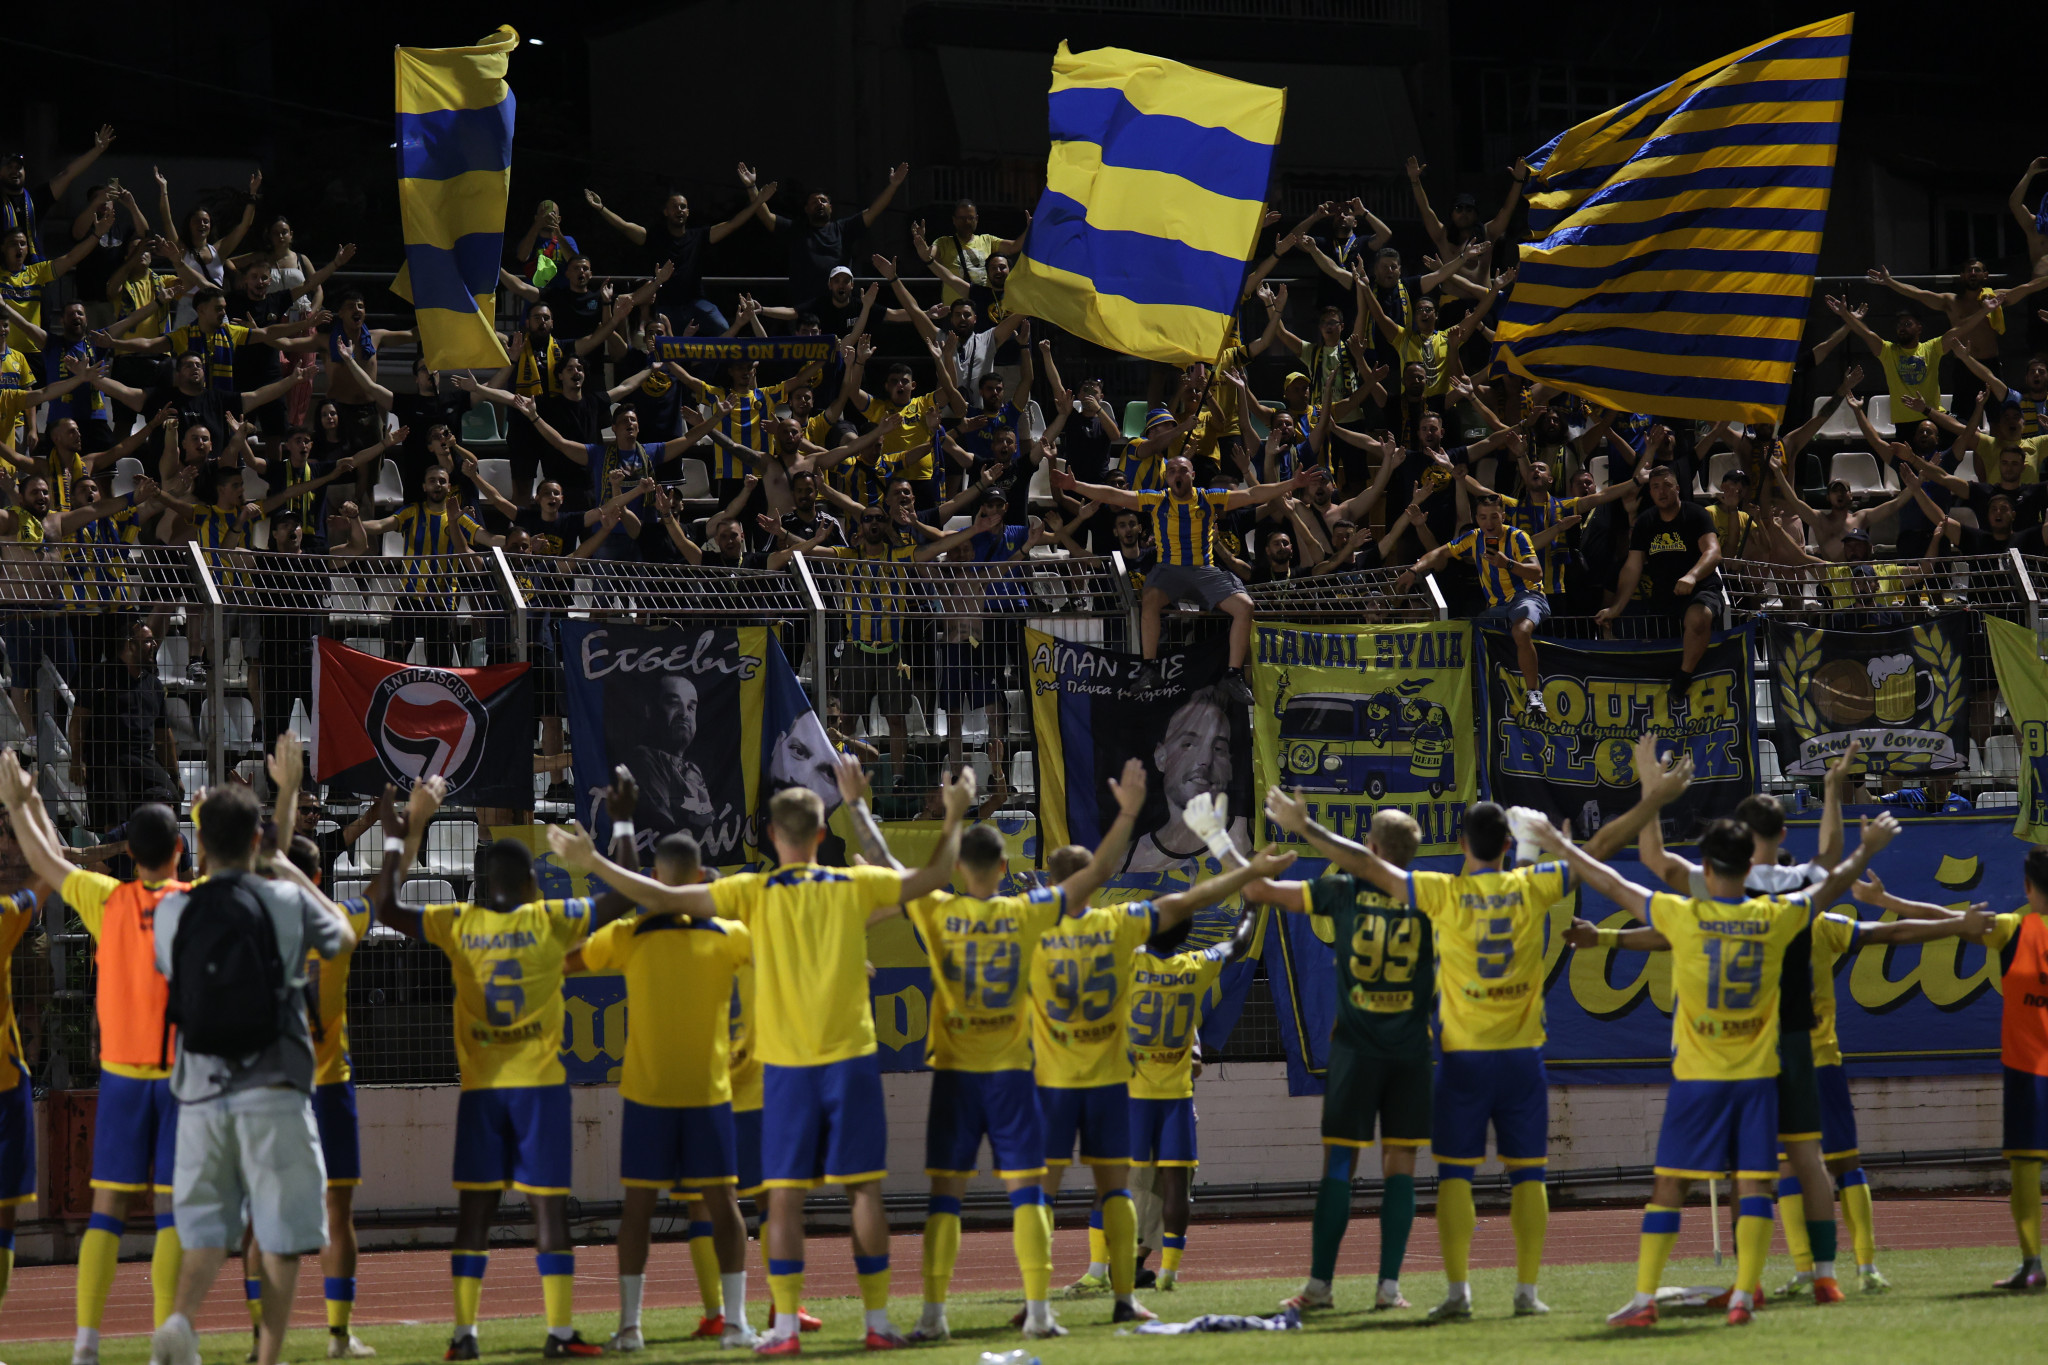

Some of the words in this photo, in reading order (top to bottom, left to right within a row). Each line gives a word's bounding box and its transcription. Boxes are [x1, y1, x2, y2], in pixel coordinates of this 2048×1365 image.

[662, 343, 742, 360] ALWAYS
[747, 344, 774, 359] ON
[778, 343, 830, 360] TOUR
[1257, 627, 1369, 674] ΠΑΝΑΙ,
[1375, 632, 1466, 669] ΞΥΔΙΑ
[383, 669, 475, 706] ANTIFASCIST
[1117, 681, 1186, 701] μχητής.
[1497, 663, 1738, 728] YOUTH
[1515, 712, 1556, 732] Made
[1559, 721, 1576, 735] in
[1579, 722, 1639, 740] Agrinio
[1685, 715, 1723, 733] 2010
[1414, 755, 1440, 765] BEER
[1327, 801, 1468, 845] ΤΑΔΙΑ
[942, 939, 1021, 1009] 49
[1349, 913, 1423, 983] 99
[1476, 917, 1514, 979] 5
[1702, 937, 1764, 1009] 19
[482, 958, 525, 1026] 6
[1045, 953, 1118, 1023] 35
[1130, 990, 1196, 1048] 90
